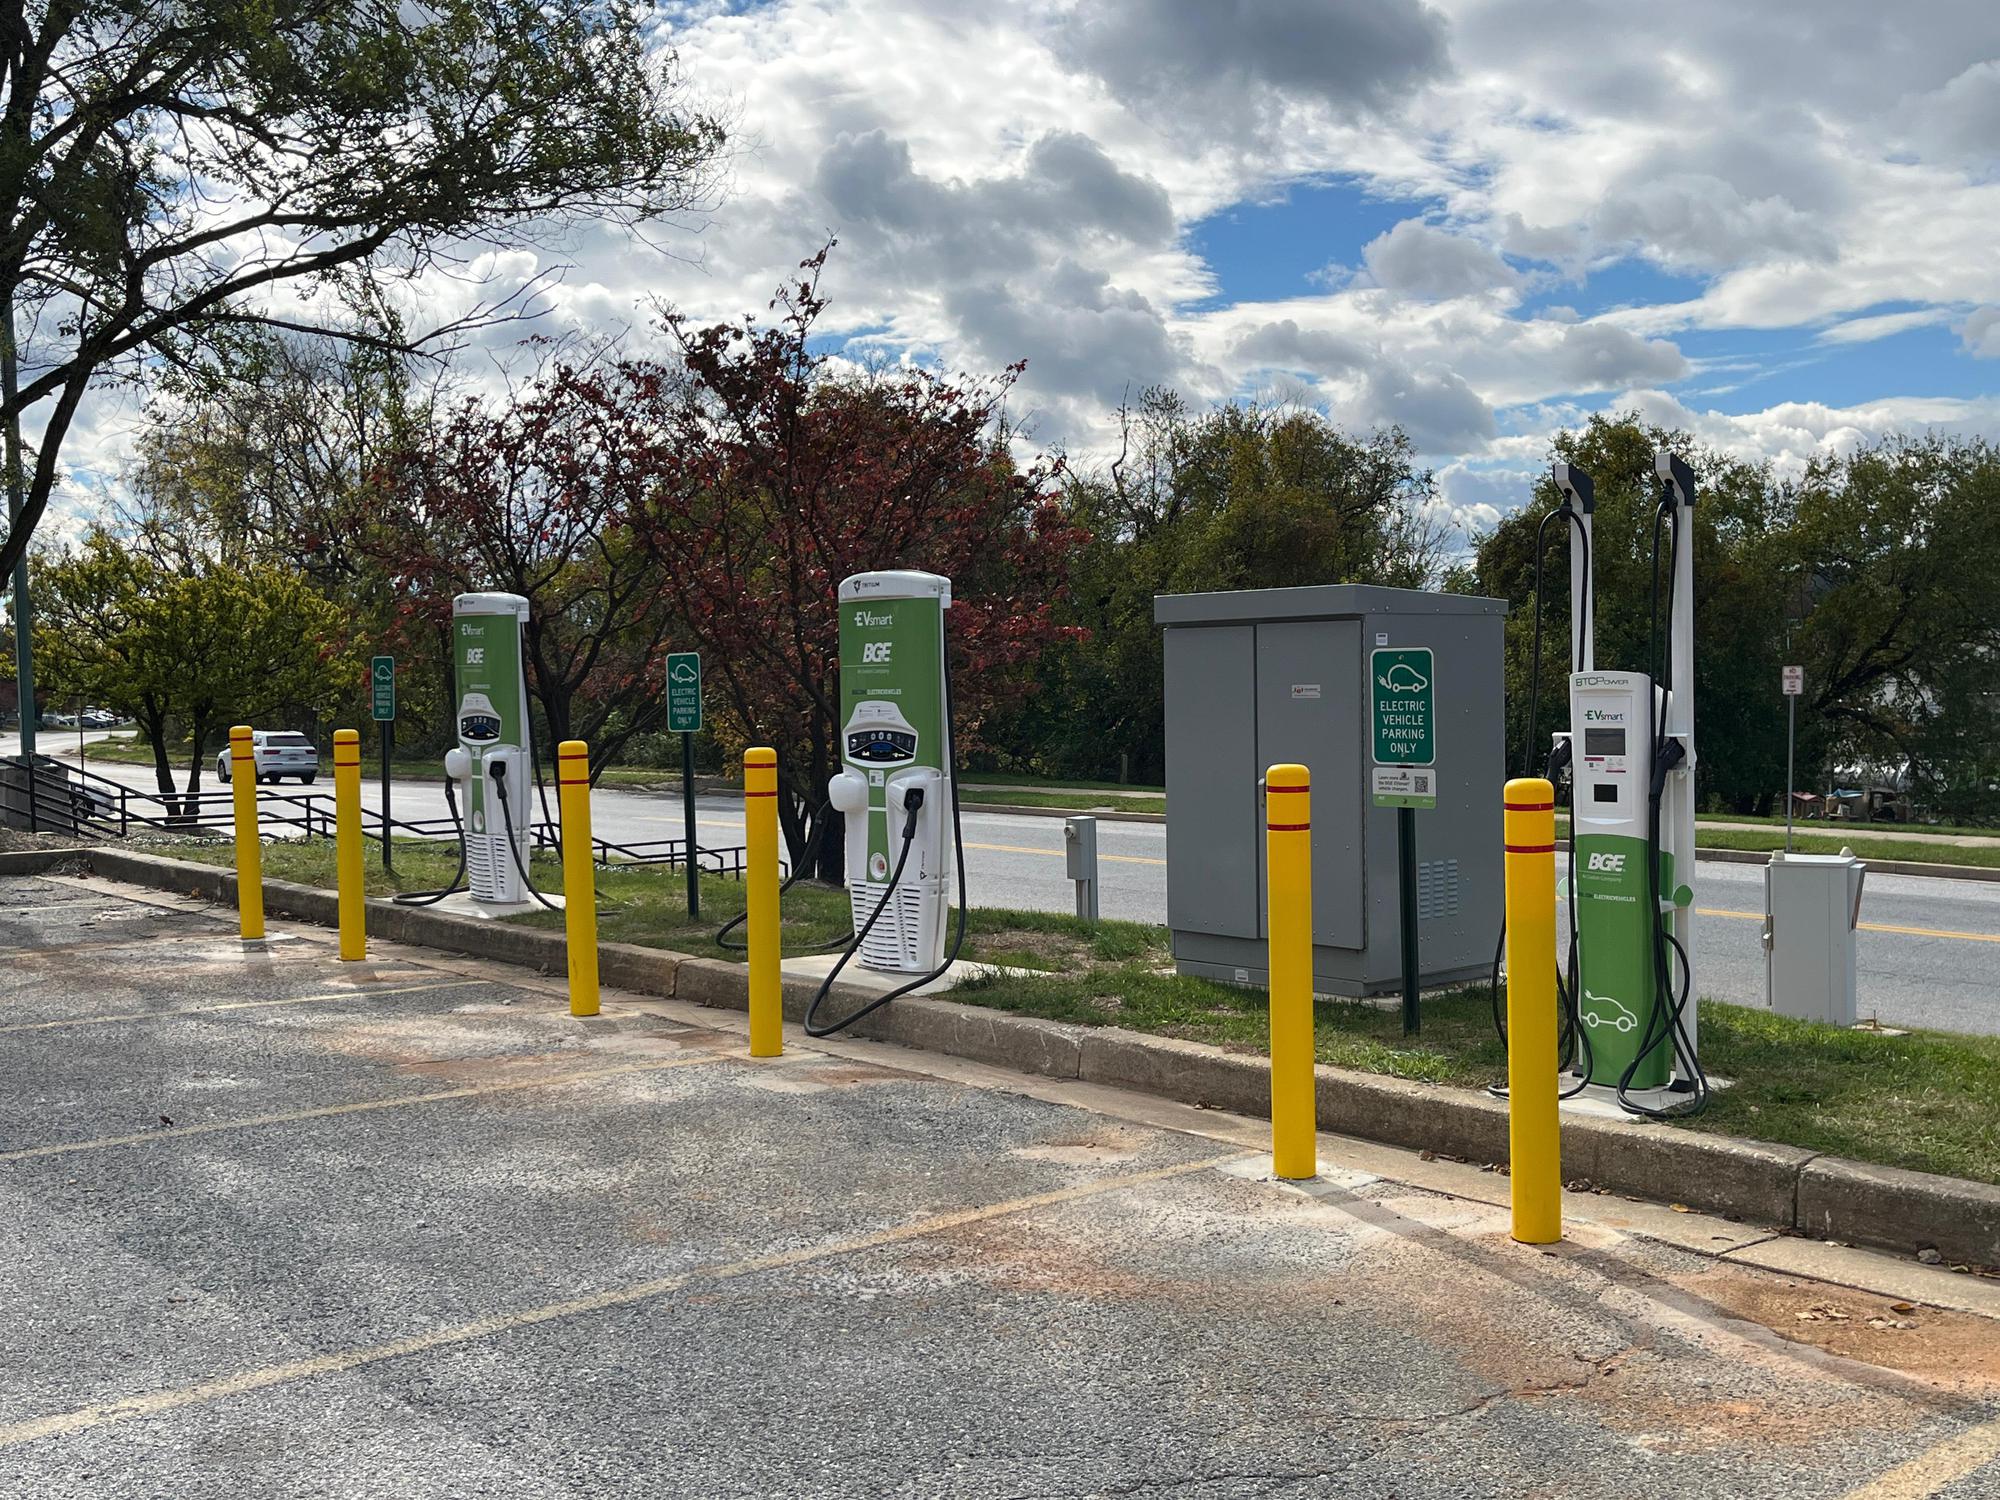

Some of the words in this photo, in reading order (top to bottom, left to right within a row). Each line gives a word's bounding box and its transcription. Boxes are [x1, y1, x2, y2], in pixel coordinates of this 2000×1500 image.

[466, 647, 485, 664] BGE
[862, 642, 892, 663] BGE
[671, 687, 696, 697] ELECTRIC
[673, 697, 696, 705] VEHICLE
[1380, 700, 1426, 711] ELECTRIC
[672, 706, 697, 715] PARKING
[677, 716, 693, 724] ONLY
[1382, 714, 1425, 726] VEHICLE
[1382, 728, 1425, 740] PARKING
[1390, 742, 1417, 753] ONLY
[1588, 852, 1626, 872] BGE
